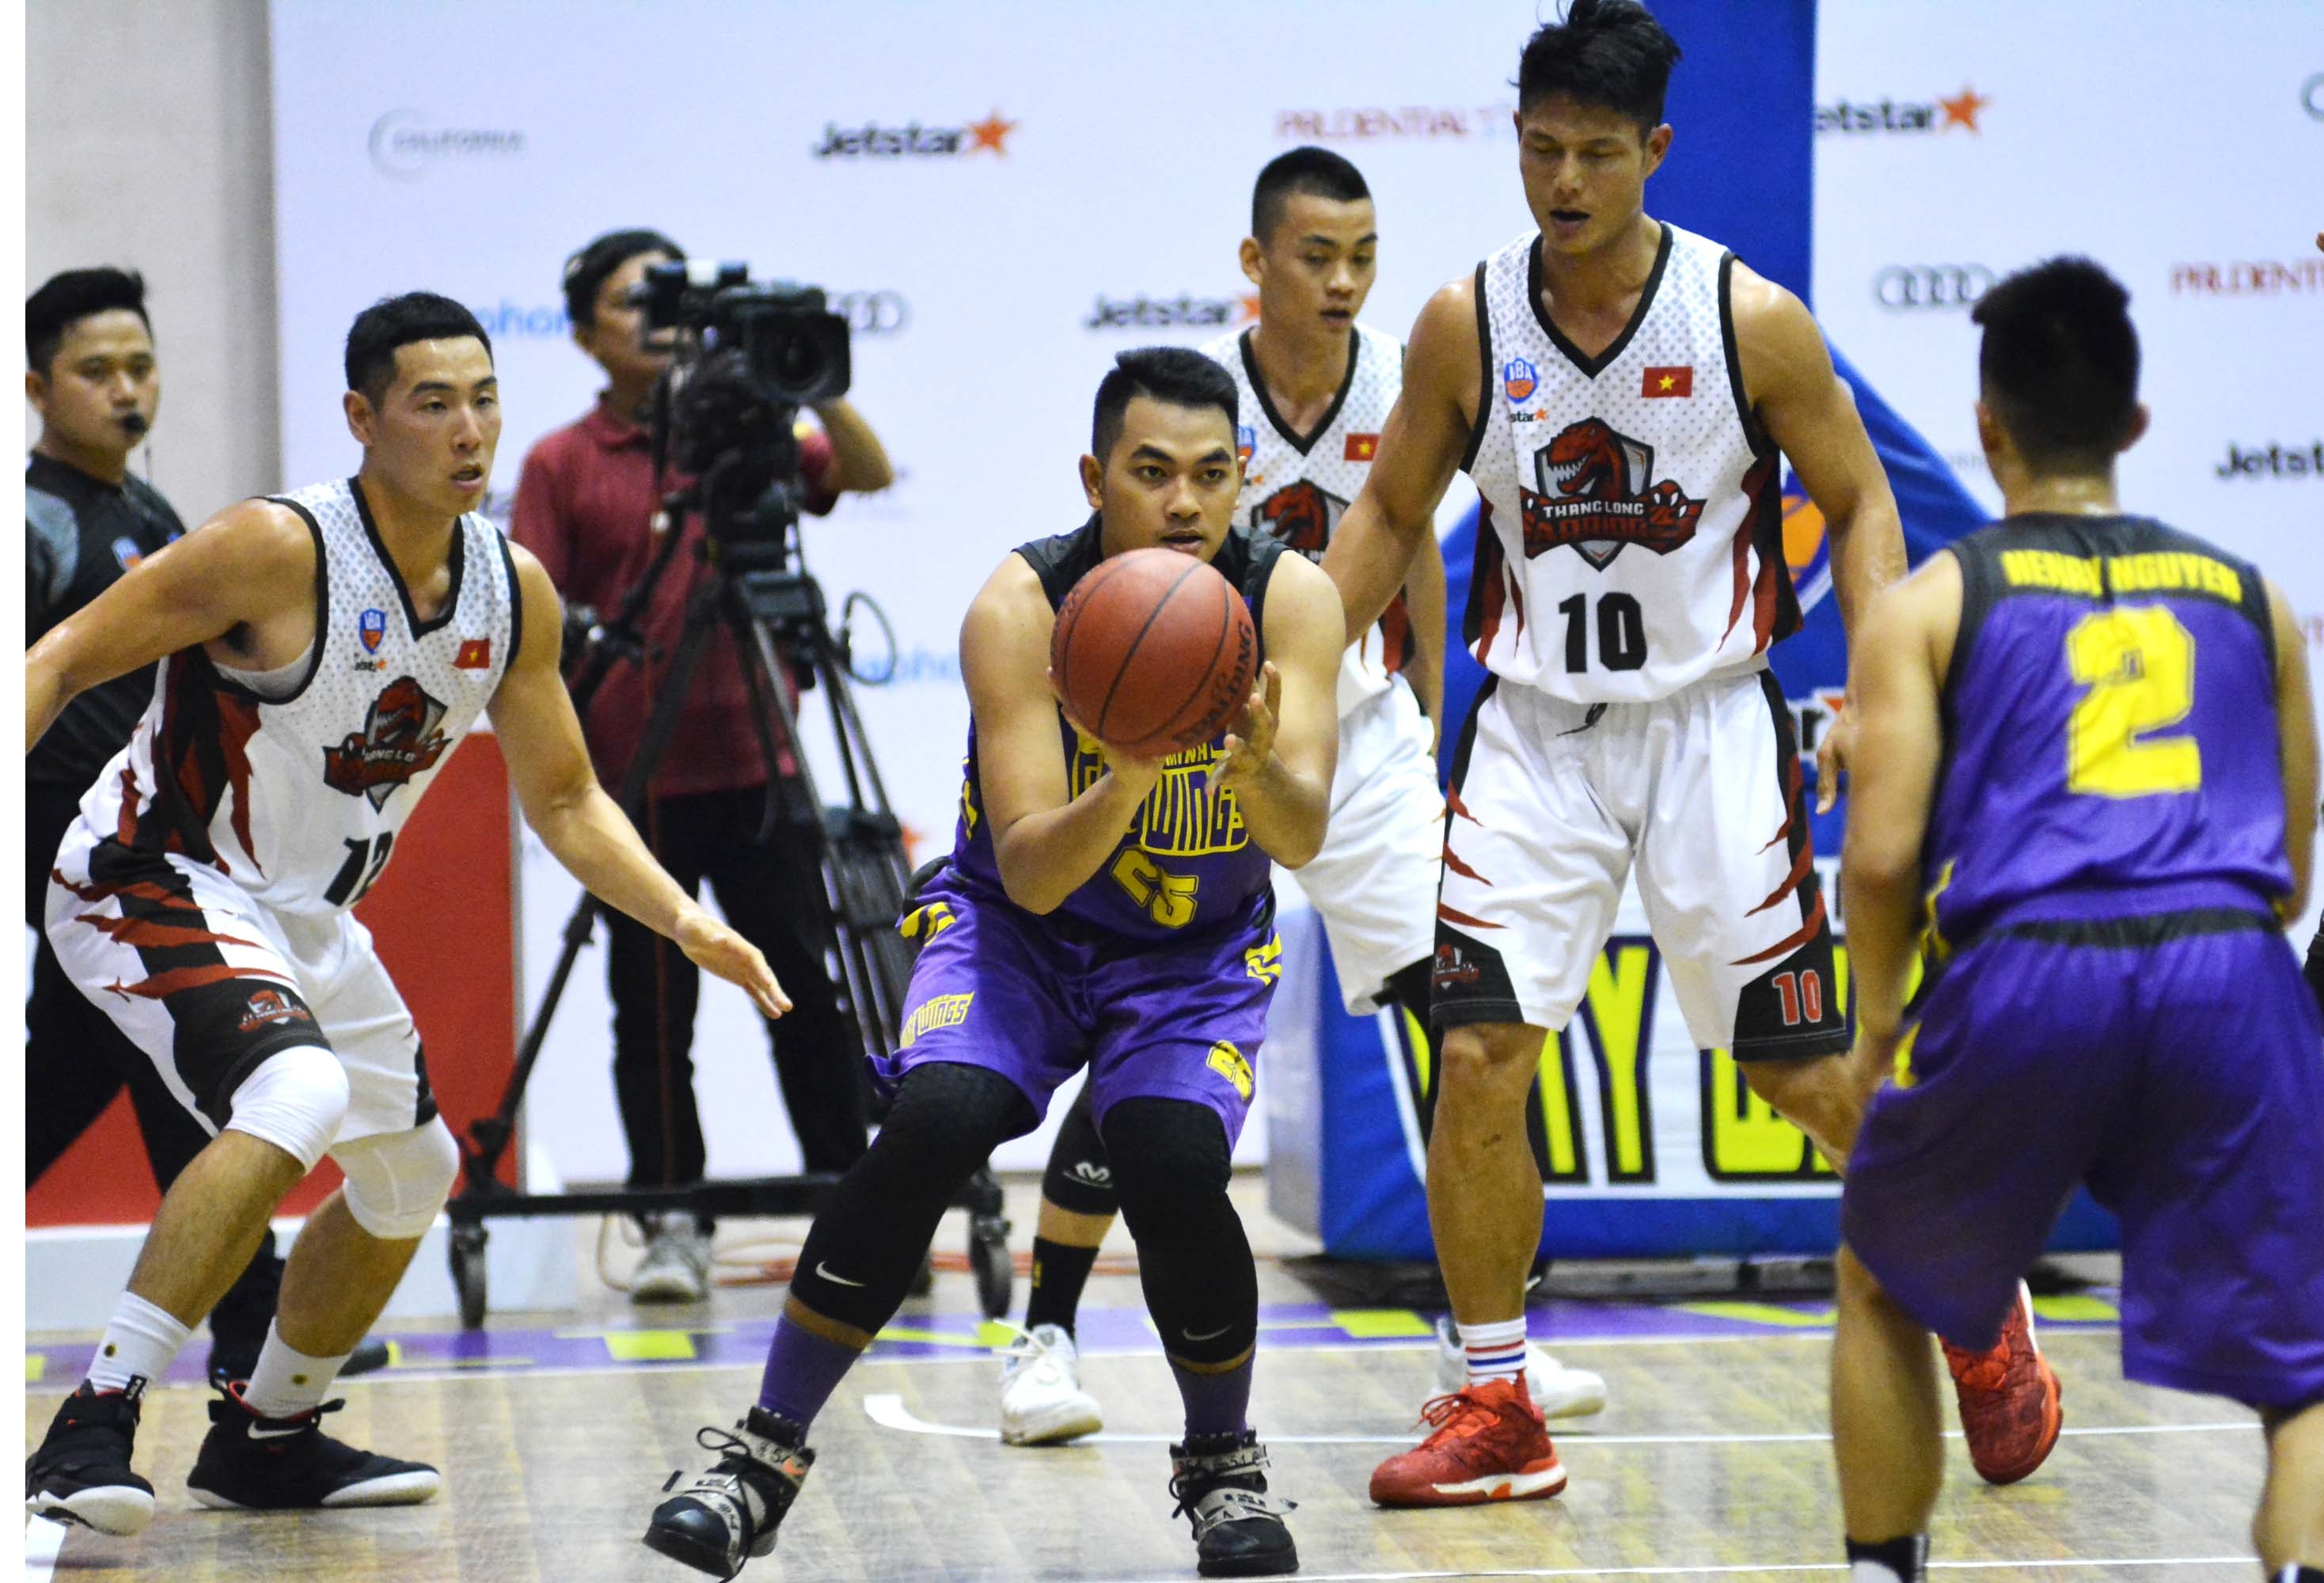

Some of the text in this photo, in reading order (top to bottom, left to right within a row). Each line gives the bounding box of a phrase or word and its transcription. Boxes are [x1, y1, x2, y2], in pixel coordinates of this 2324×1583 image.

[812, 121, 962, 158] Jetstar
[1087, 293, 1229, 328] Jetstar
[1544, 500, 1644, 518] THANG LONG
[2003, 549, 2243, 603] HENRY NGUYEN
[1558, 592, 1647, 673] 10
[2064, 603, 2202, 798] 2
[1771, 969, 1822, 1026] 10
